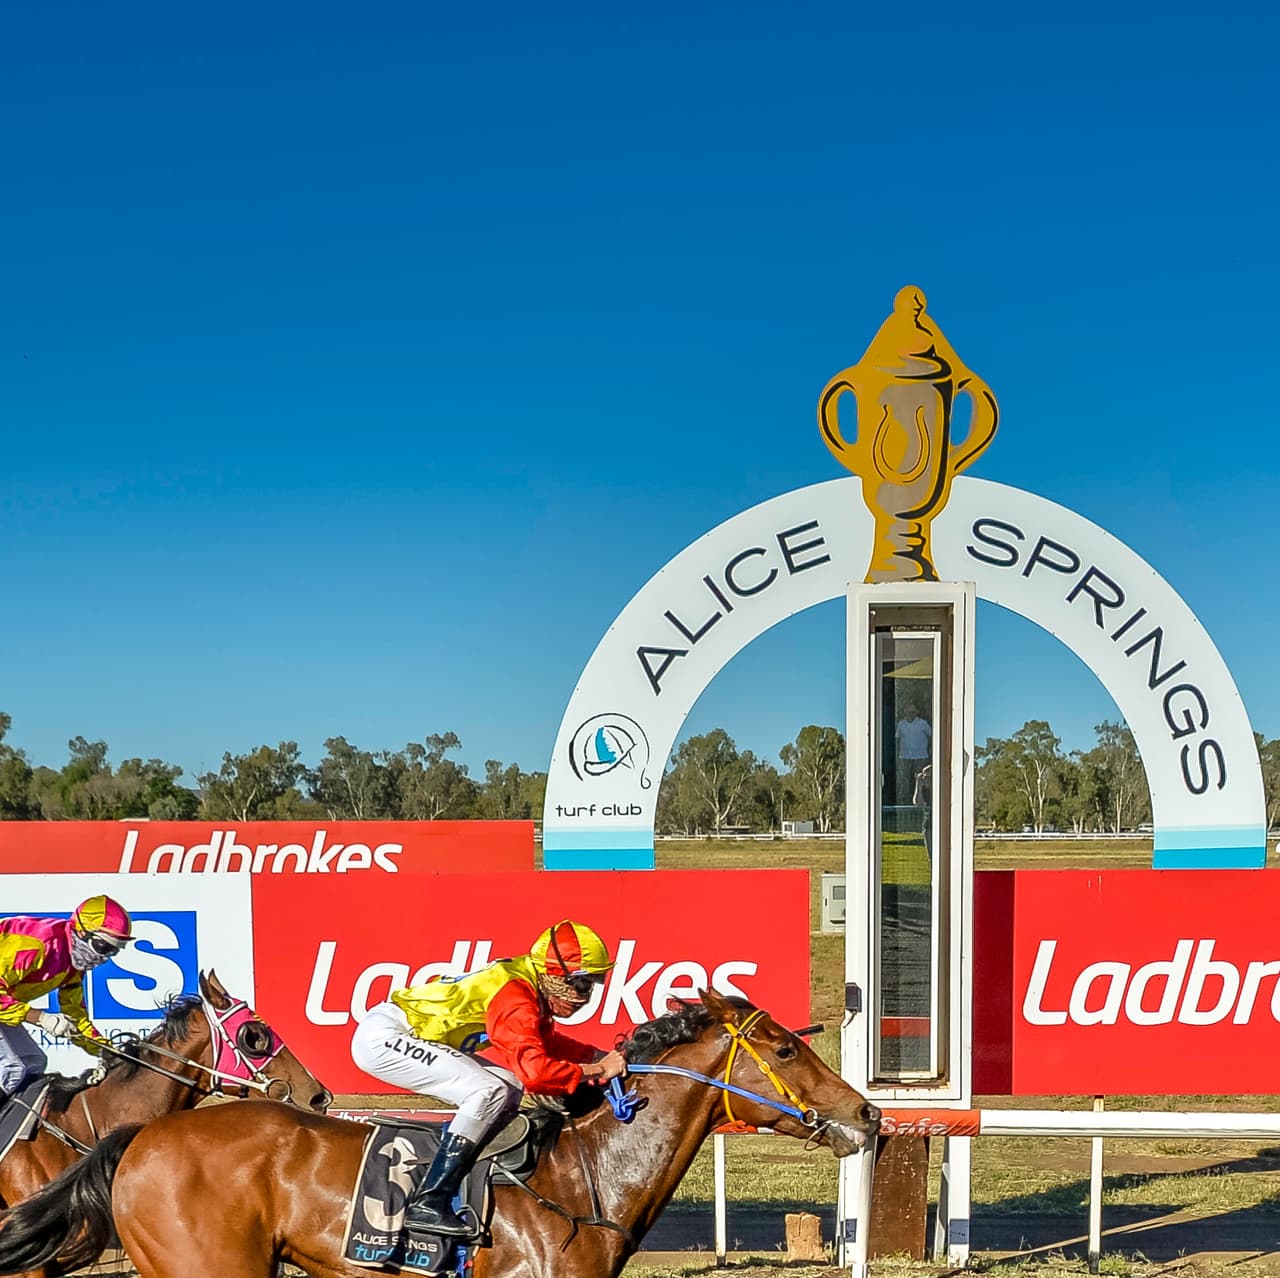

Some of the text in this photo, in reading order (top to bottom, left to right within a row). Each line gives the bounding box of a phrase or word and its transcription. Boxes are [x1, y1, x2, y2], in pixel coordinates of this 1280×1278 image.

[636, 518, 1227, 795] ALICE SPRINGS
[555, 803, 642, 816] turf club
[118, 830, 403, 872] Ladbrokes
[363, 1136, 418, 1232] 3
